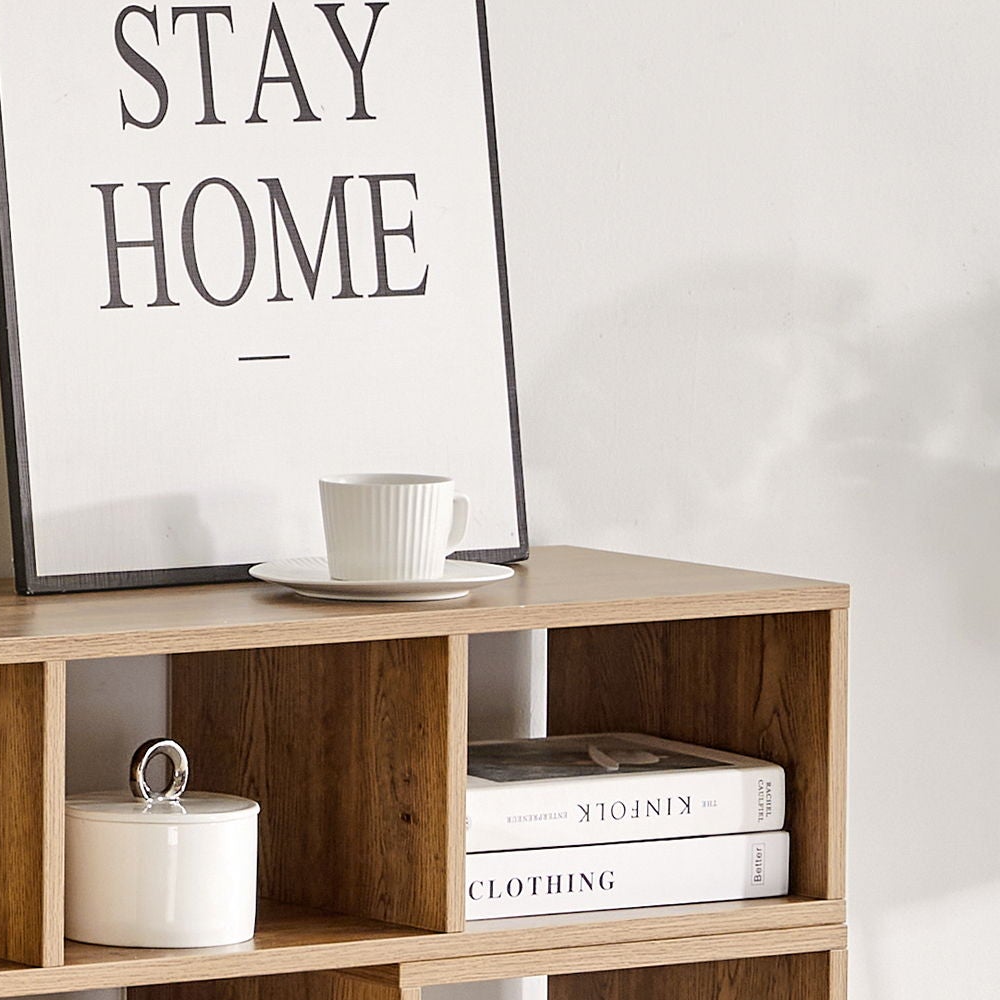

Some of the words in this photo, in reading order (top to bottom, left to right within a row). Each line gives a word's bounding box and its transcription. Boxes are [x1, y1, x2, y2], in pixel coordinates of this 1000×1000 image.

[114, 2, 390, 130] STAY
[90, 173, 429, 309] HOME
[577, 796, 692, 823] KINFOLK
[702, 799, 718, 808] THE
[753, 847, 763, 883] Better
[468, 870, 616, 901] CLOTHING
